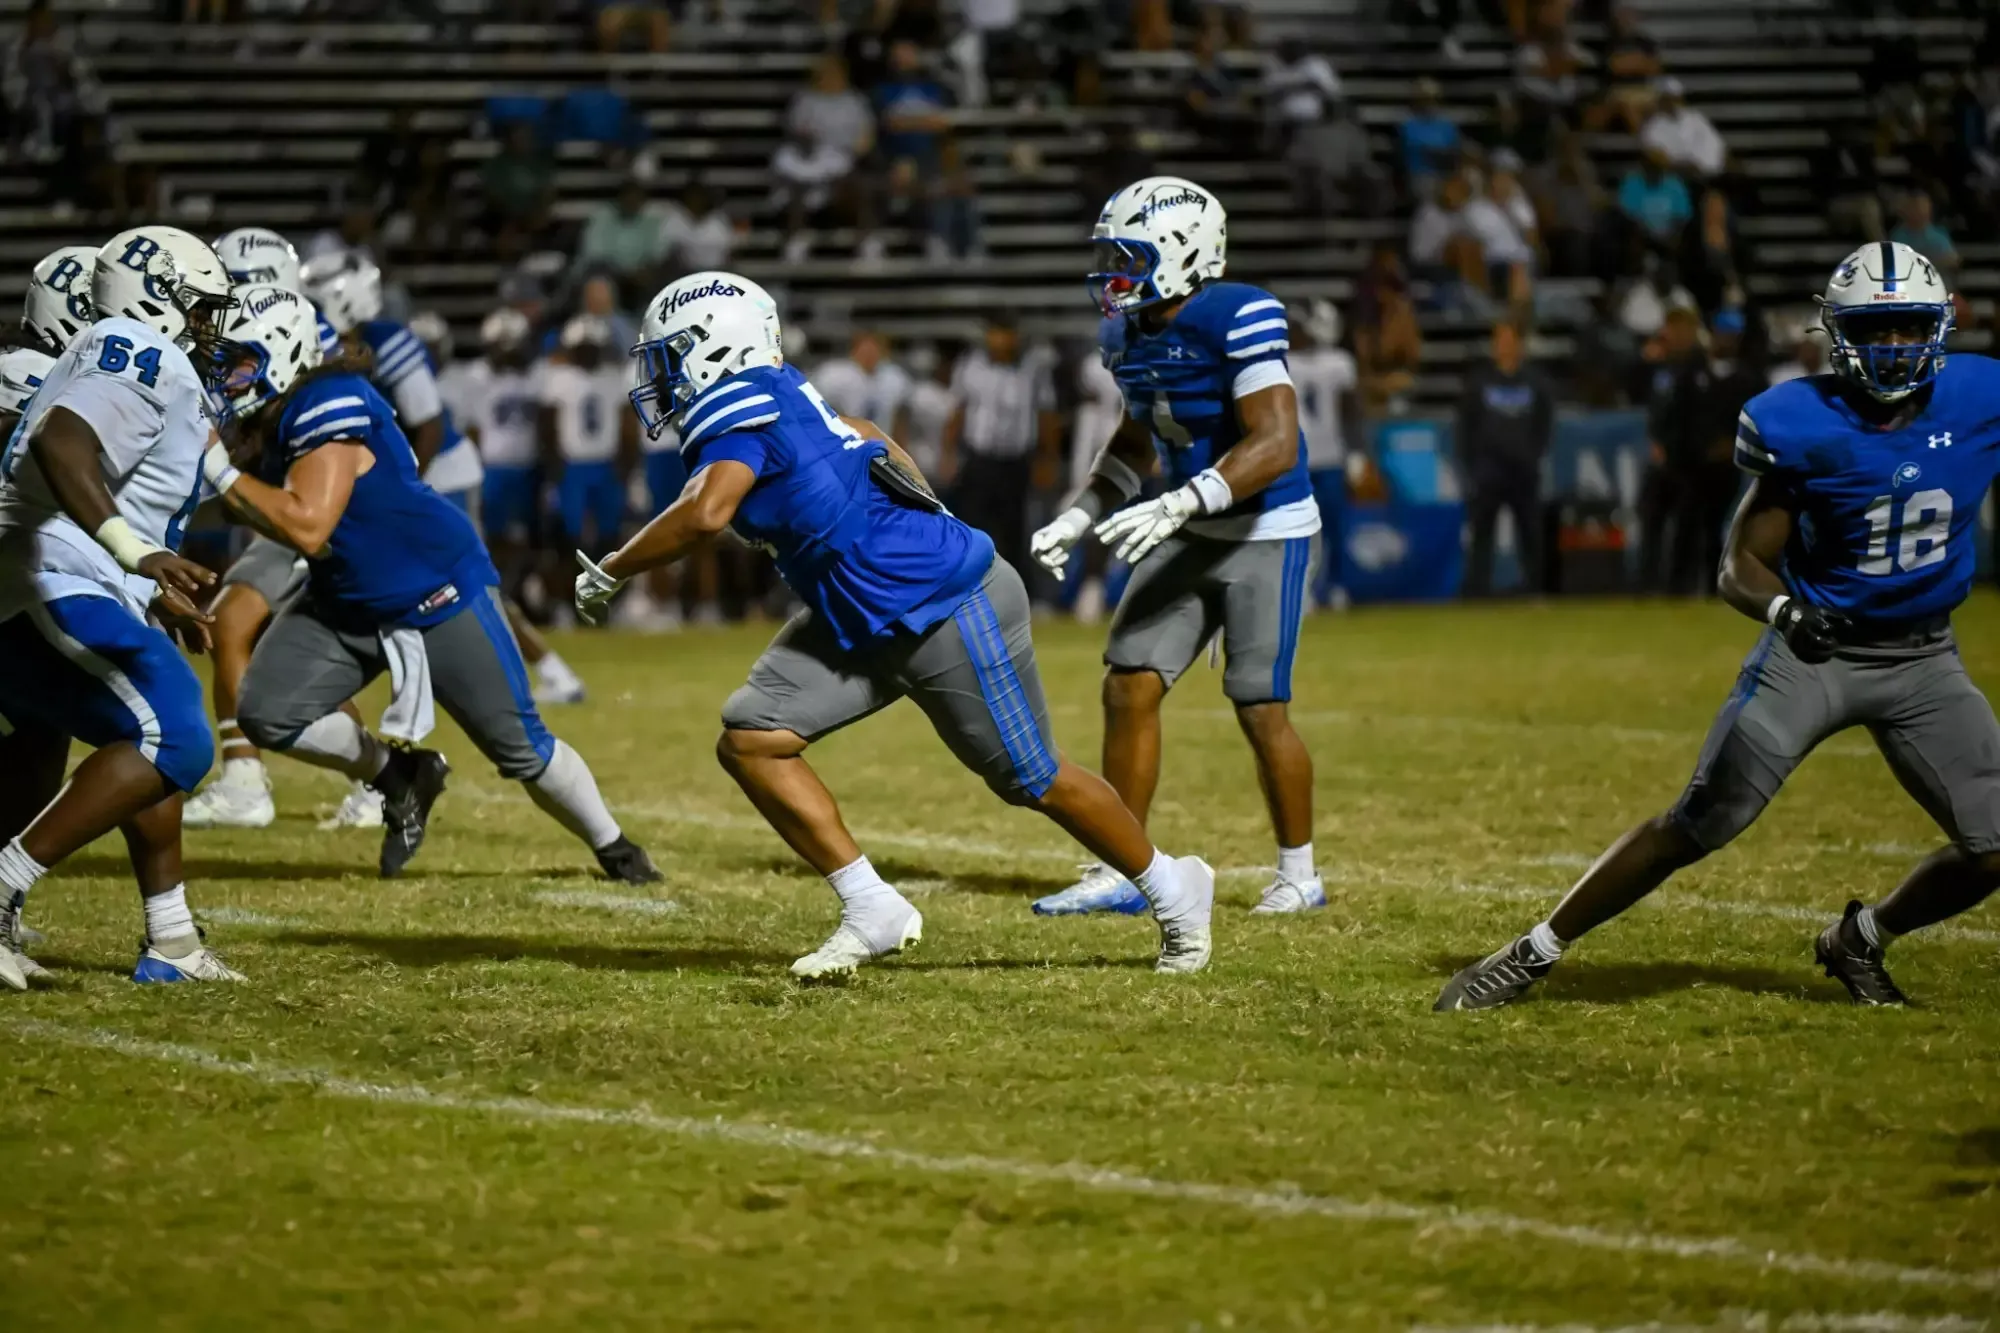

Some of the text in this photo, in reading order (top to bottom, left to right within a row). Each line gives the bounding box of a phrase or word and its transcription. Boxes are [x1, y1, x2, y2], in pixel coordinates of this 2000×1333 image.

[659, 279, 736, 324] Hawks
[97, 334, 163, 390] 64
[1856, 488, 1953, 576] 18
